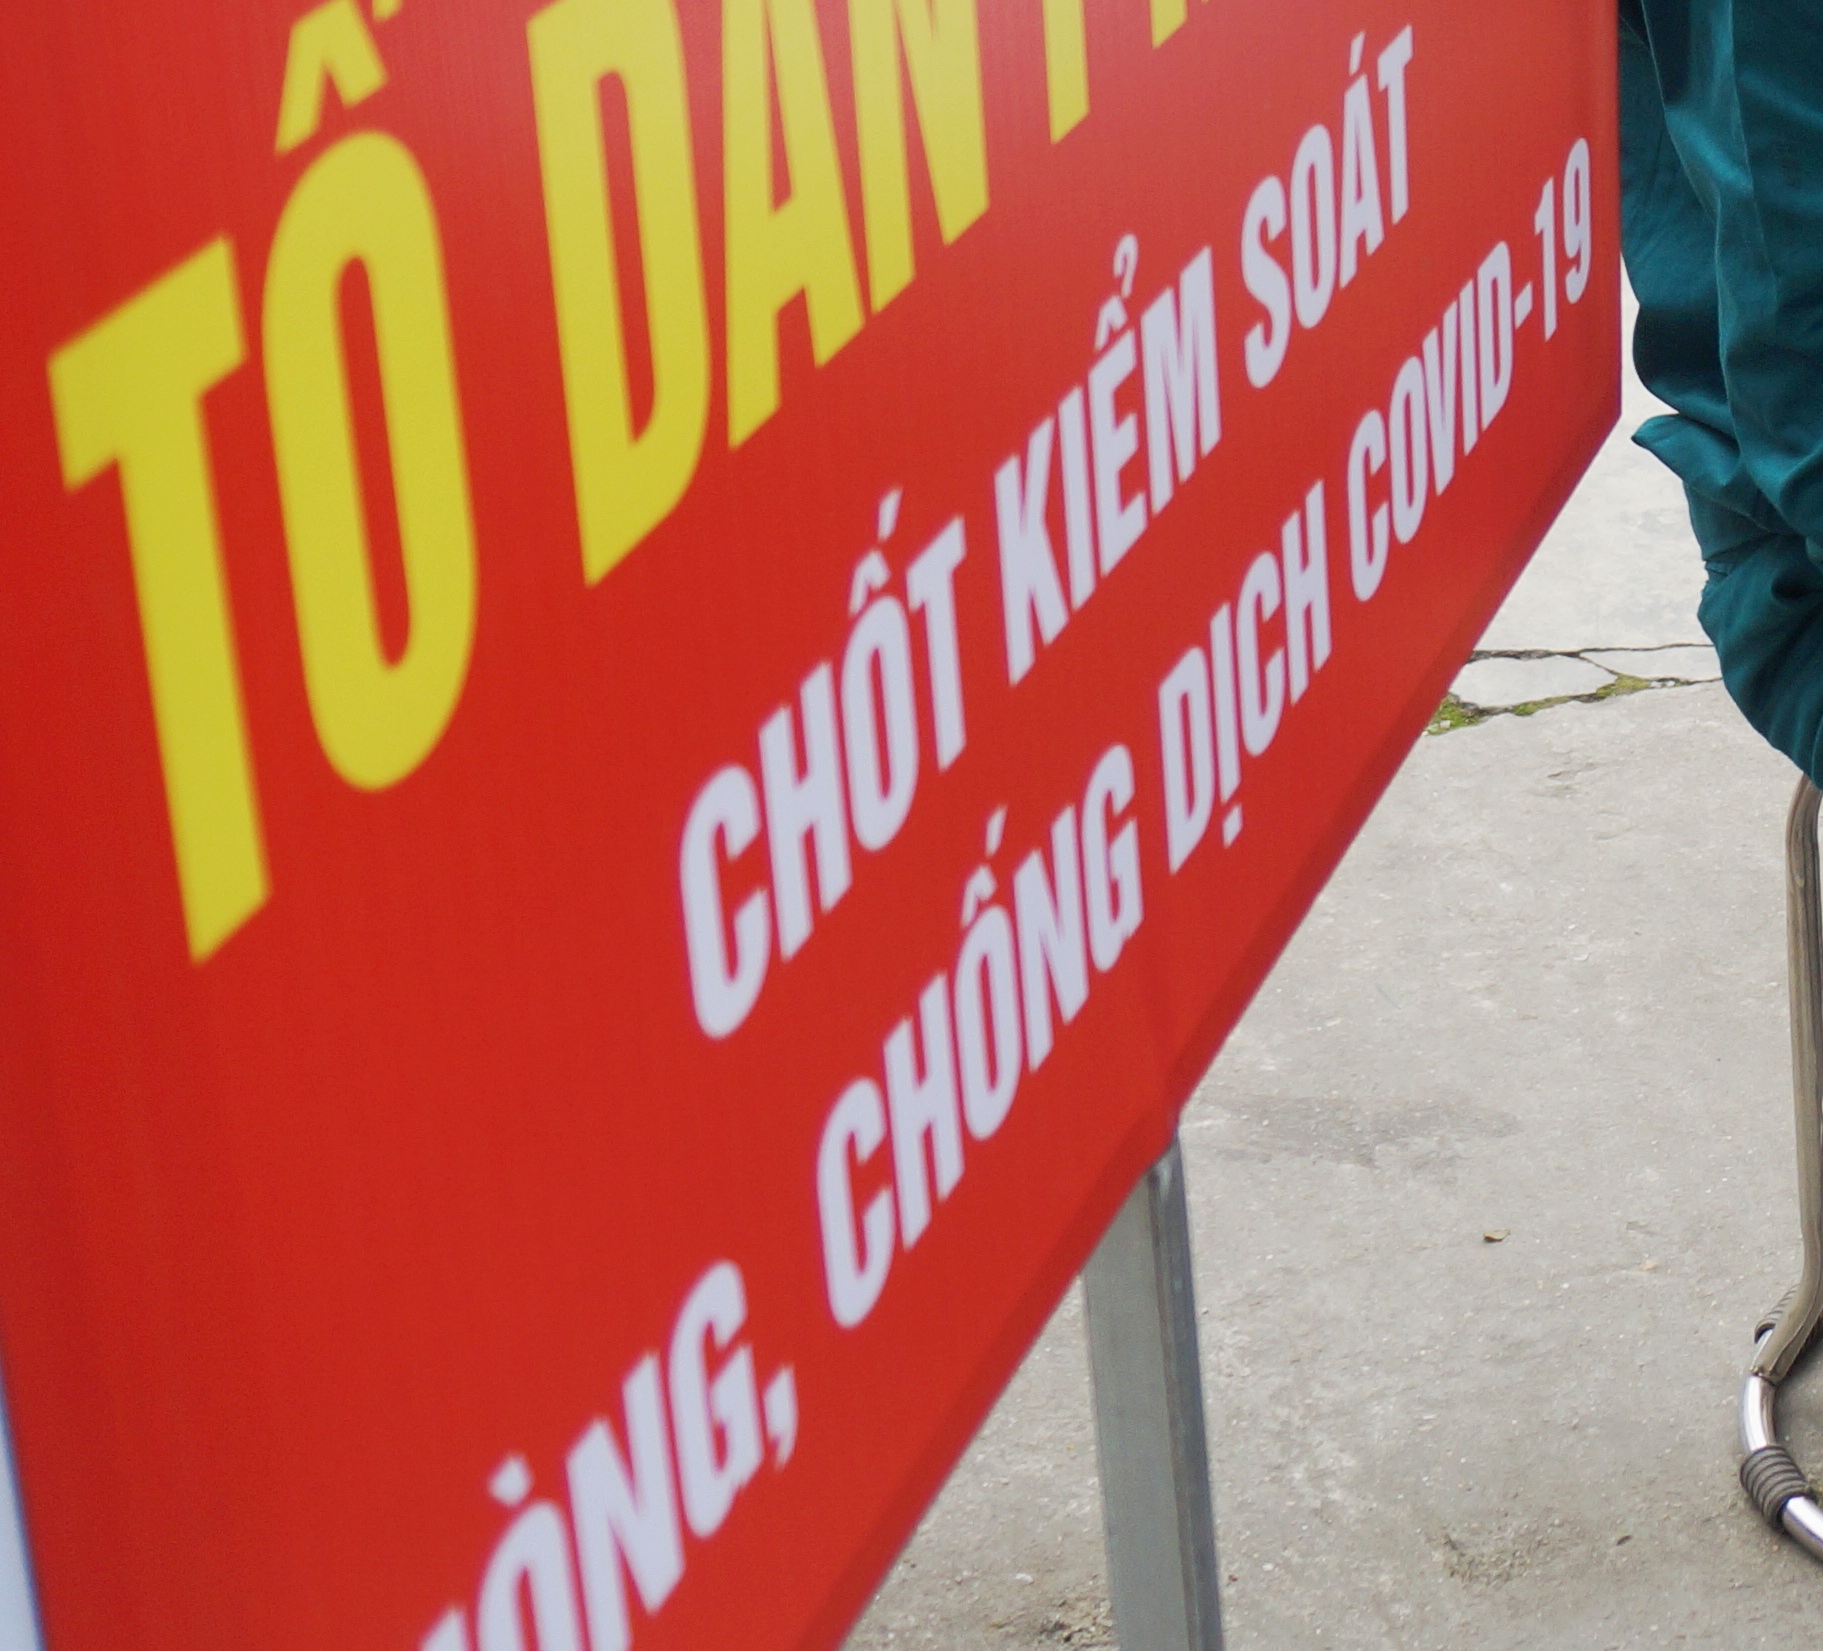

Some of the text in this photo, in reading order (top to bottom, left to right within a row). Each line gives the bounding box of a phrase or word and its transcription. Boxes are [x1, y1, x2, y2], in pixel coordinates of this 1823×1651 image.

[420, 137, 1592, 1651] ÒNG, CHỐNG DỊCH COVID-19
[680, 24, 1414, 1039] CHỐT KIỂM SOÁT
